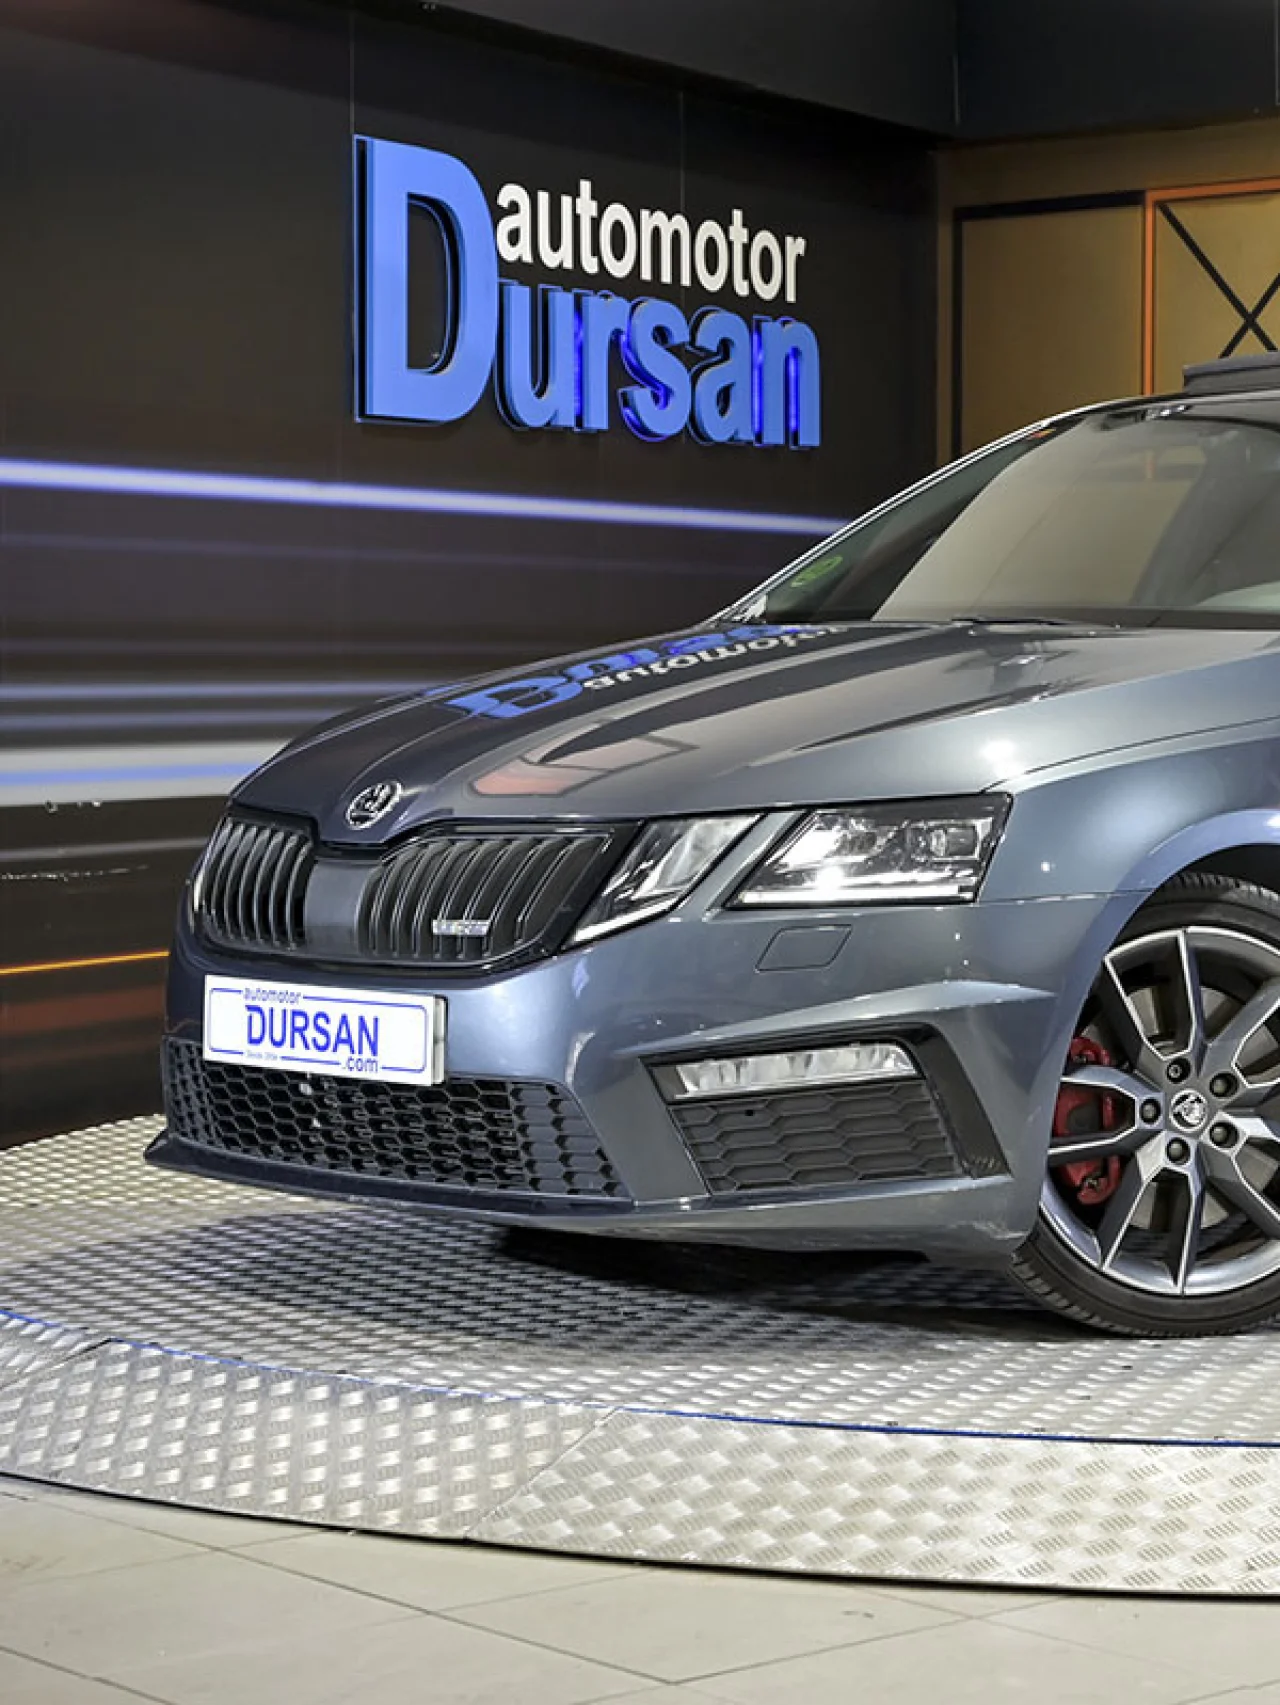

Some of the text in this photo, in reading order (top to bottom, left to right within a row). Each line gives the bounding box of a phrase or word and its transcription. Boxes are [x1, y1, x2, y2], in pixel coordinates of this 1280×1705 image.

[496, 177, 806, 303] automotor
[353, 133, 821, 449] Dursan
[243, 987, 302, 1005] automotor
[244, 1004, 379, 1057] DURSAN
[341, 1056, 379, 1074] .com
